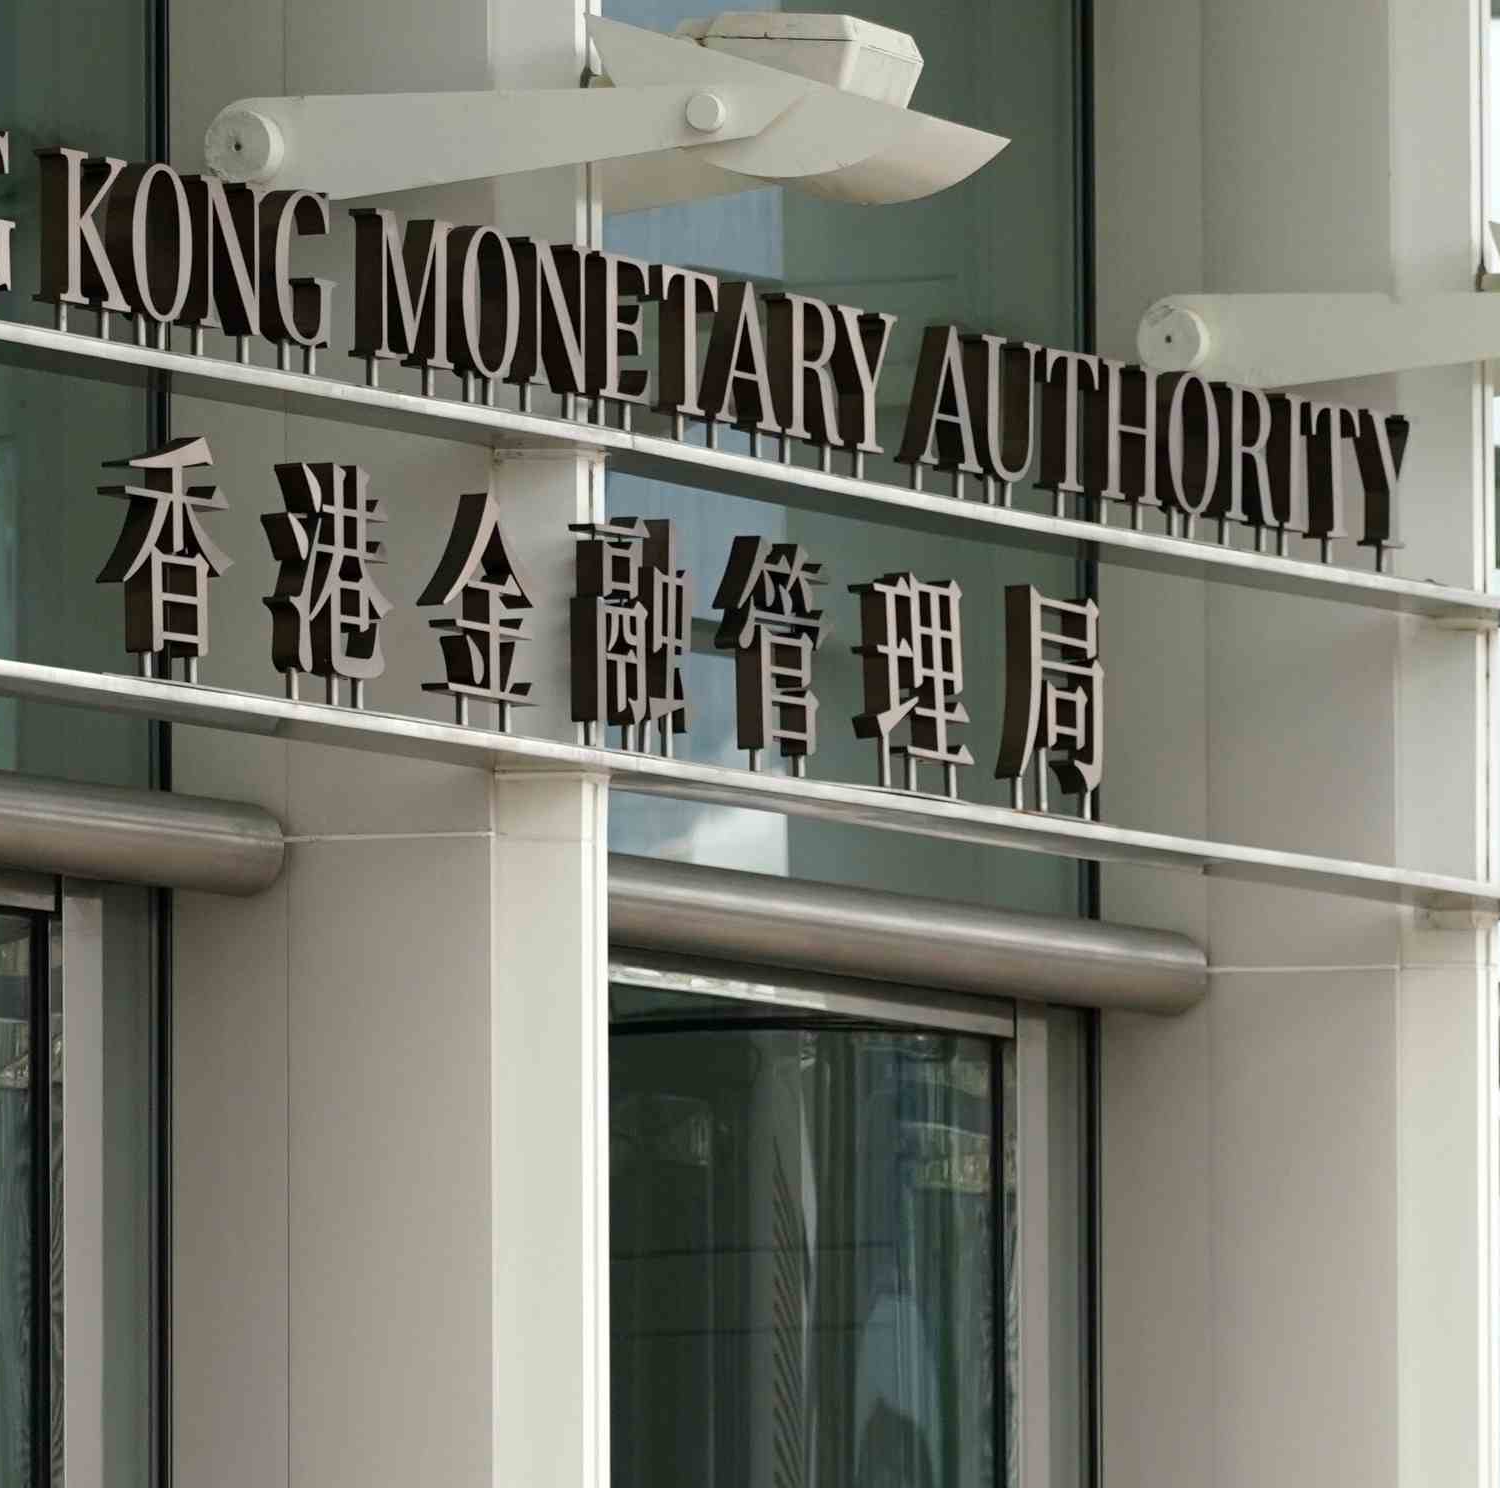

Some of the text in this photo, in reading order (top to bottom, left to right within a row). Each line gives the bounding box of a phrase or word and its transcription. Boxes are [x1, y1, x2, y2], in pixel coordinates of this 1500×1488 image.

[33, 145, 338, 349] KONG
[348, 206, 897, 456] MONETARY
[897, 322, 1410, 549] AUTHORITY
[95, 436, 1105, 796] 香港金融管理局
